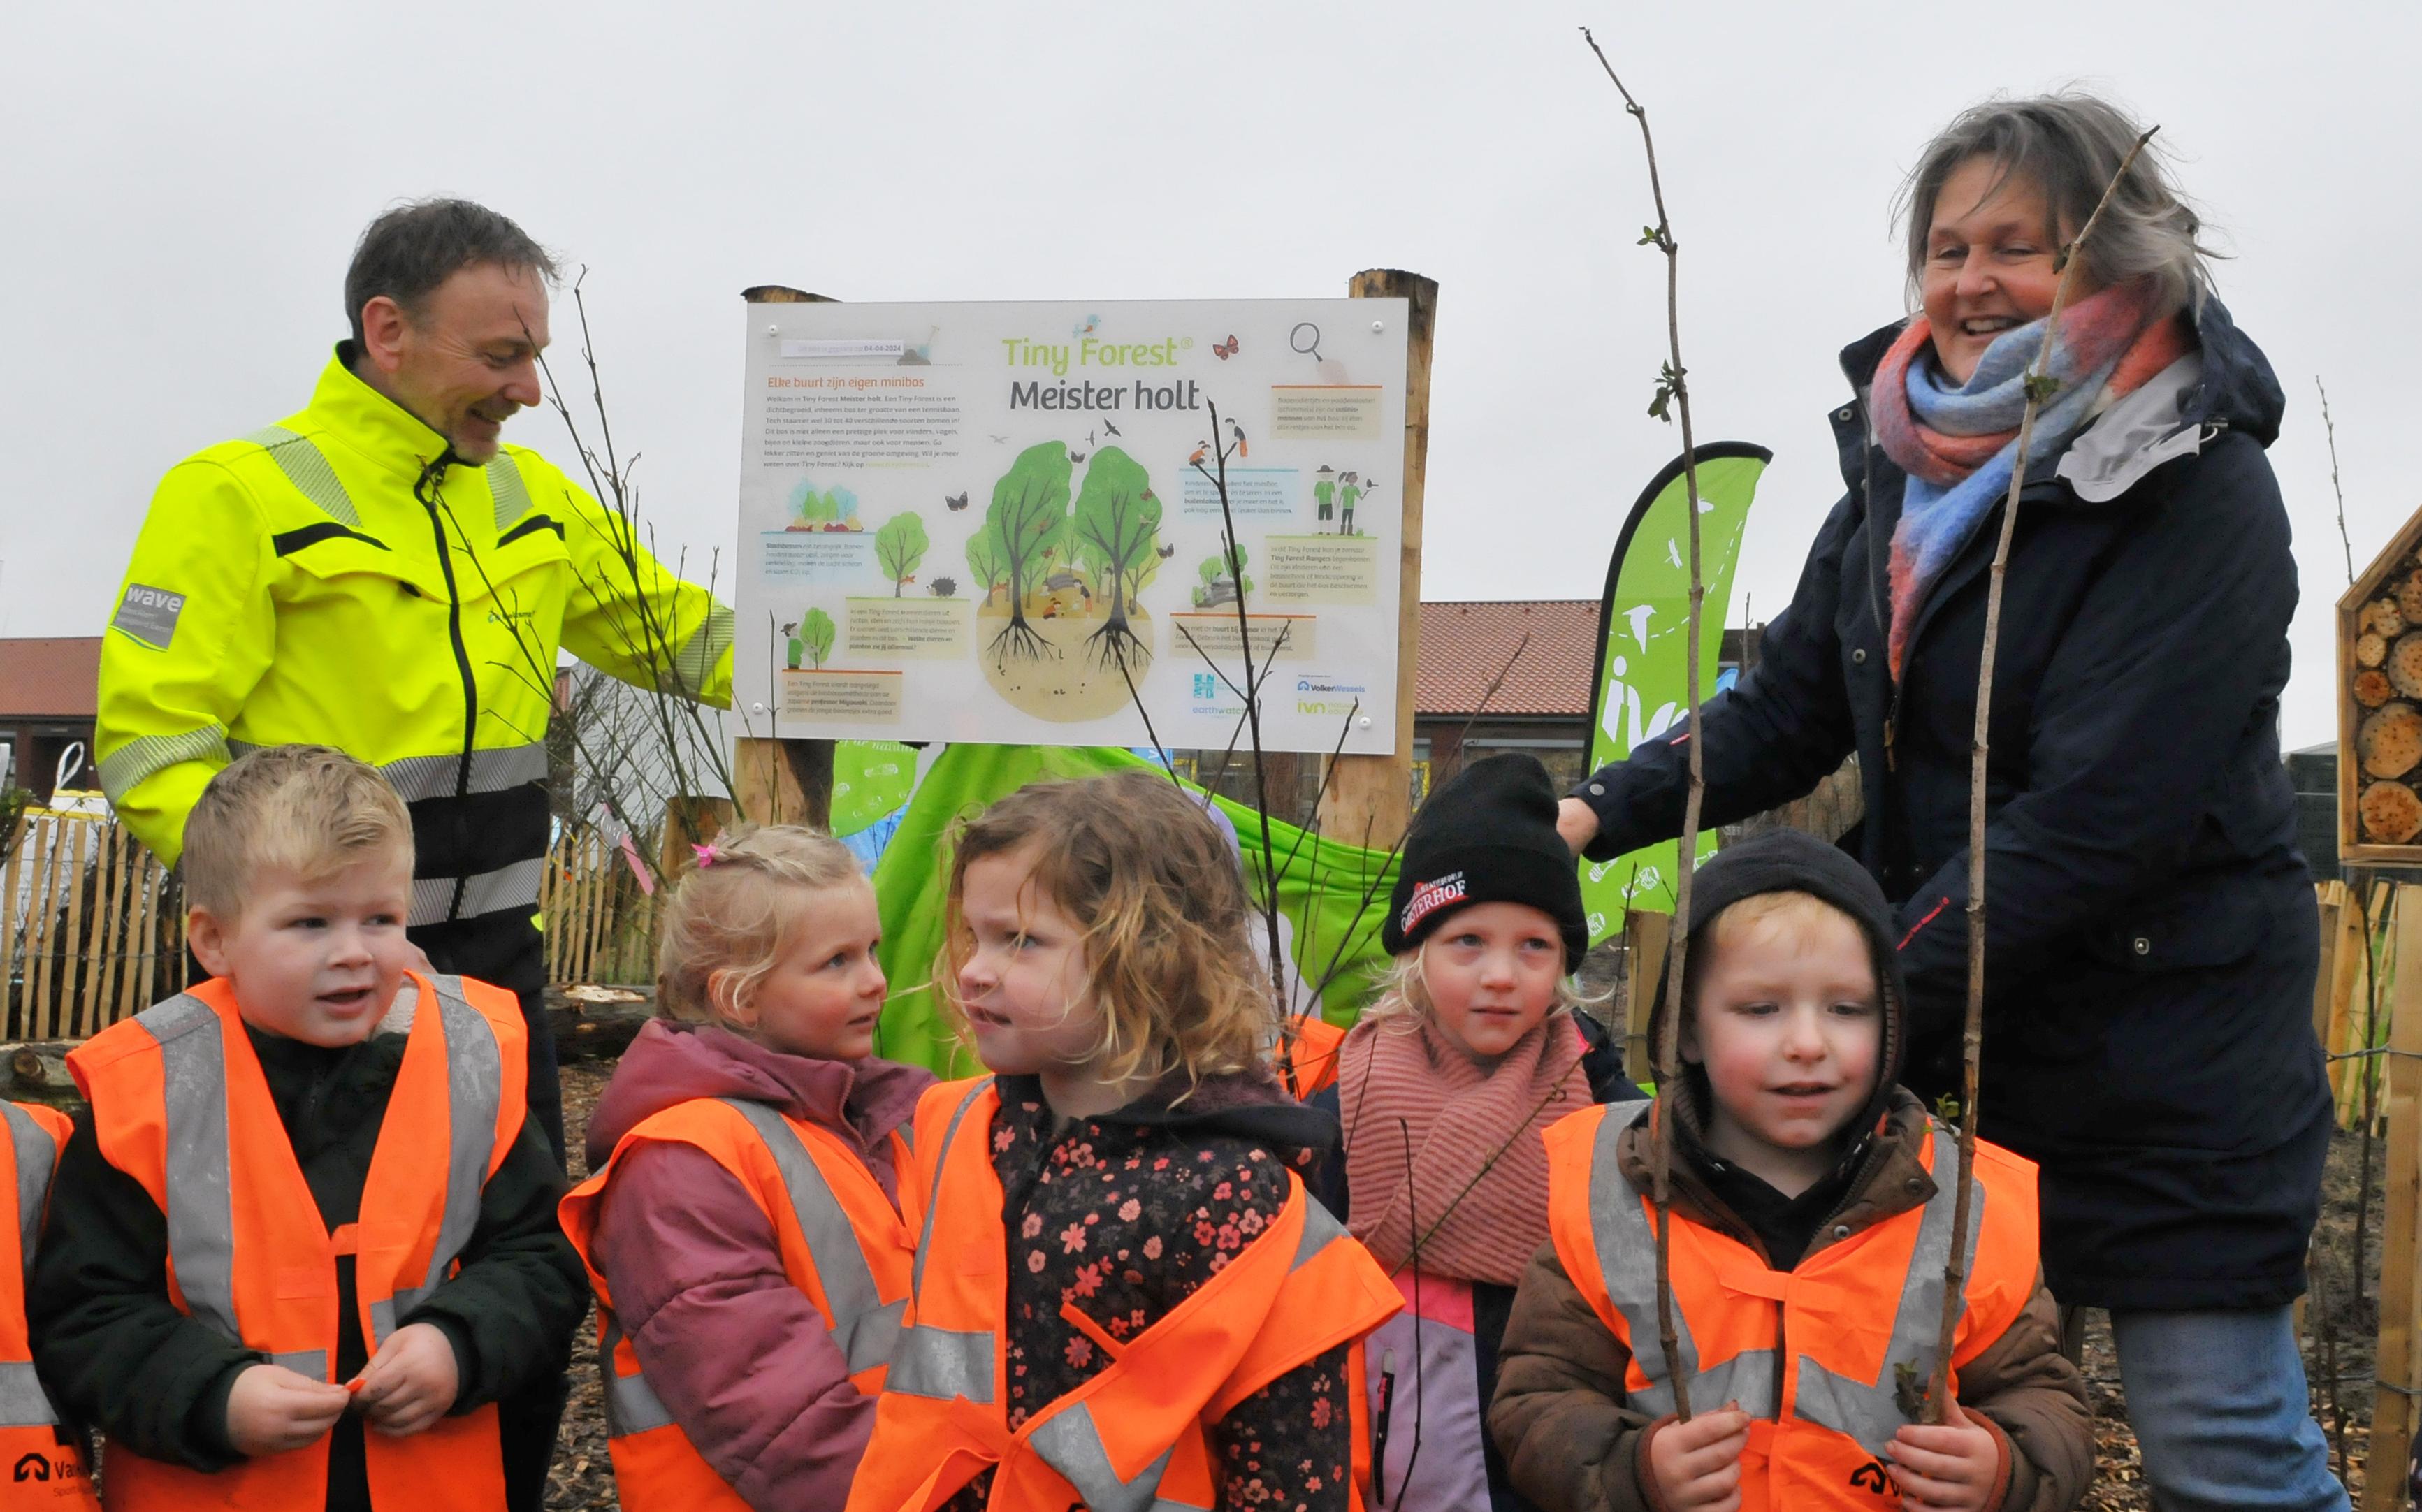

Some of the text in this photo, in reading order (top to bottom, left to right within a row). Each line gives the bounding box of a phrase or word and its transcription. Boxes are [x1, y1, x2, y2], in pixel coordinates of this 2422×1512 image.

[1002, 337, 1069, 376] Tiny
[767, 377, 924, 391] Elke buurt zijn eigen minibos
[1010, 379, 1200, 411] Meister holt
[126, 587, 182, 613] wave
[1311, 684, 1365, 693] VolkerWessels
[1298, 699, 1326, 714] ivn
[1602, 655, 1690, 753] iv
[1400, 879, 1466, 932] OOSTERHOF
